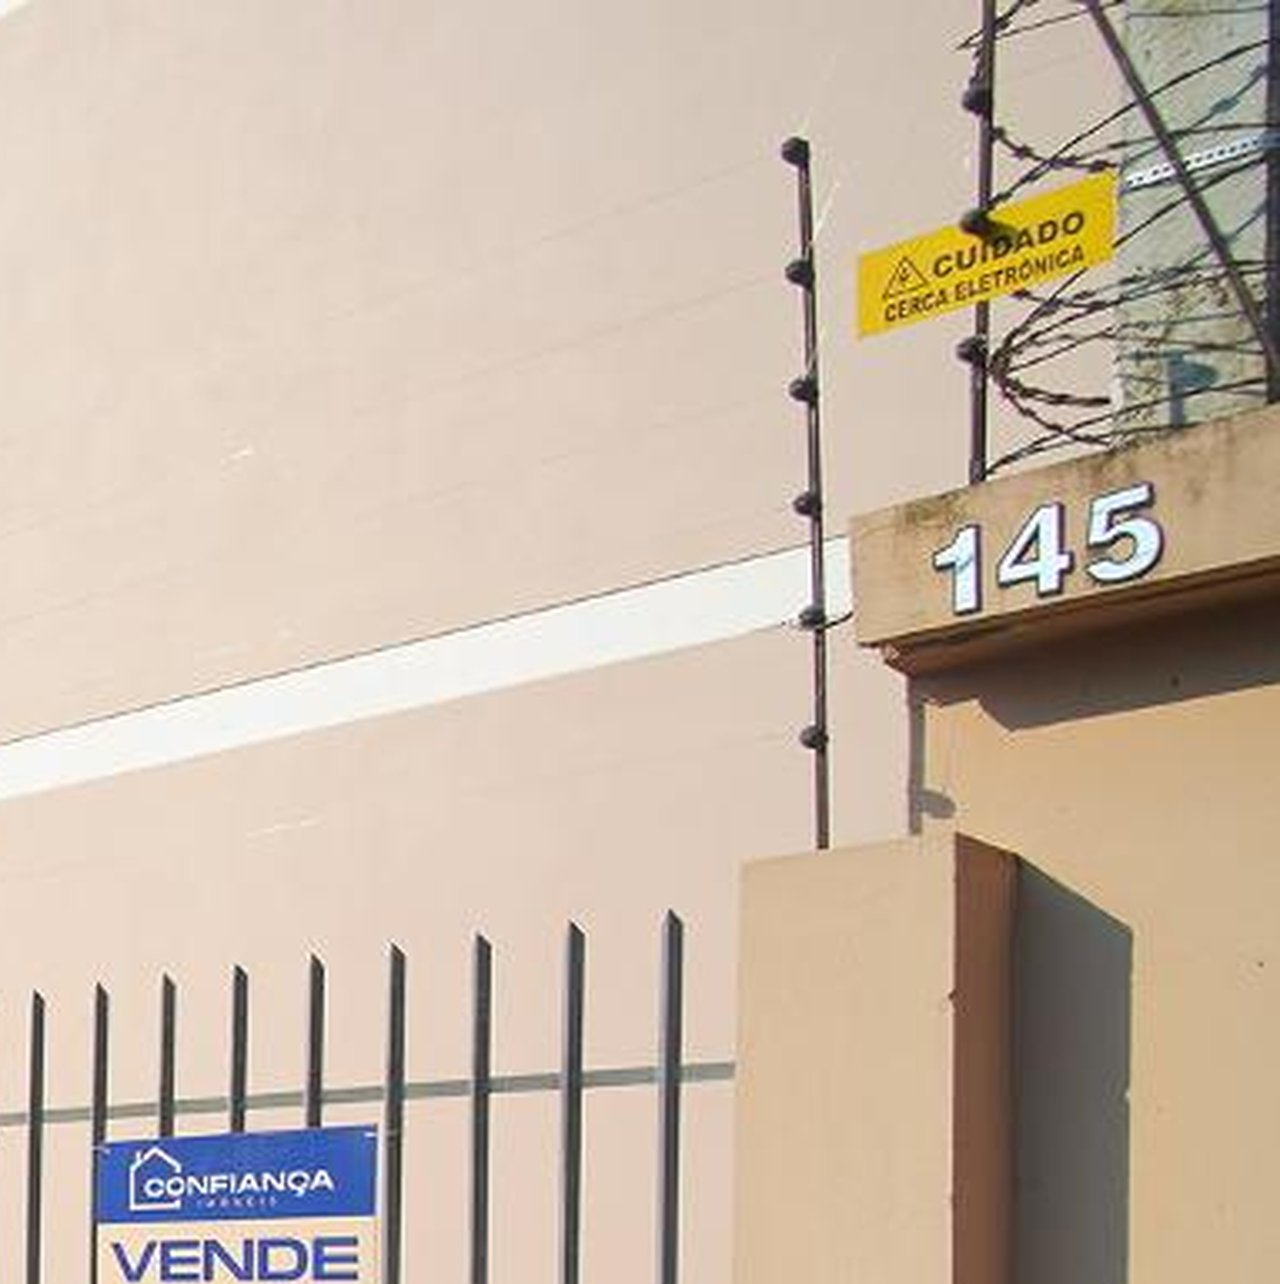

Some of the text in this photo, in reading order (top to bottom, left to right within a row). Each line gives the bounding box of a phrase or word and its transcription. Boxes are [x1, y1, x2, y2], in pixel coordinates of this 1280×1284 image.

[932, 211, 1085, 279] CUIDADO
[884, 245, 1085, 323] CERCA ELETRÔNICA
[933, 482, 1165, 616] 145
[144, 1169, 335, 1198] CONFIANÇA
[111, 1236, 359, 1283] VENDE
